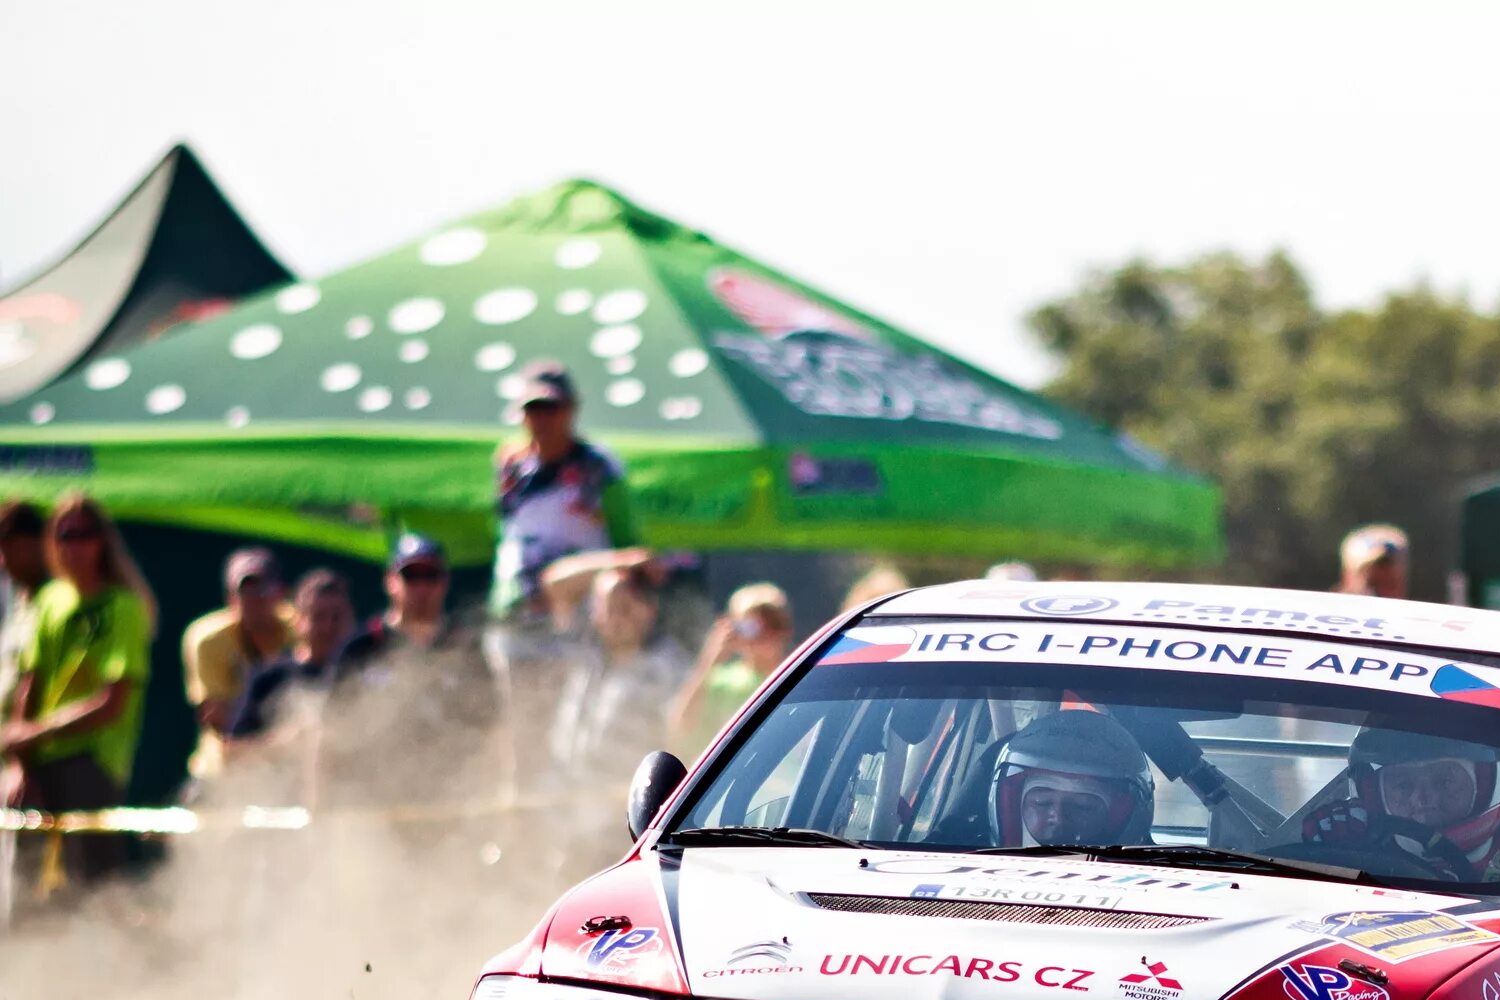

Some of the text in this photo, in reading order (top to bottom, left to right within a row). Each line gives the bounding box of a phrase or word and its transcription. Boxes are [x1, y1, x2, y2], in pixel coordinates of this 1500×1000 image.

[1142, 599, 1389, 630] Pamet
[917, 633, 1429, 681] IRC I-PHONE APP
[819, 954, 1095, 992] UNICARS CZ
[1118, 983, 1180, 998] MITSUBISHI
